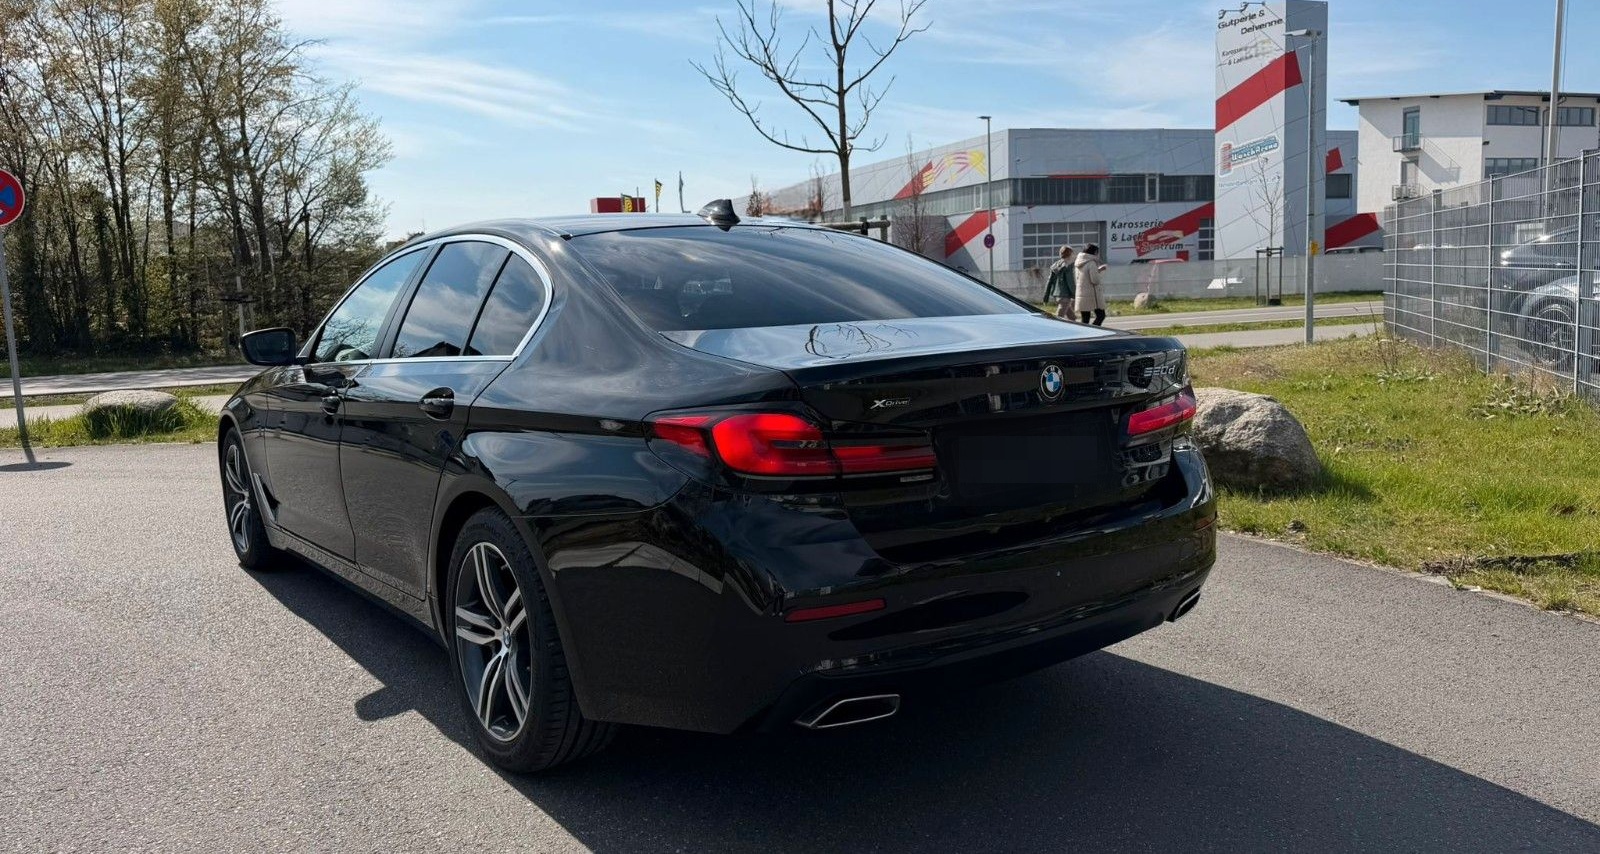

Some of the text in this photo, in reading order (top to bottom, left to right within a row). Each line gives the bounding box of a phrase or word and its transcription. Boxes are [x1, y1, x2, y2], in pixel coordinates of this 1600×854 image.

[1218, 9, 1265, 29] Gutperle &
[1240, 18, 1284, 35] Delvenne
[1110, 219, 1164, 229] Karosserie
[1111, 233, 1118, 242] &
